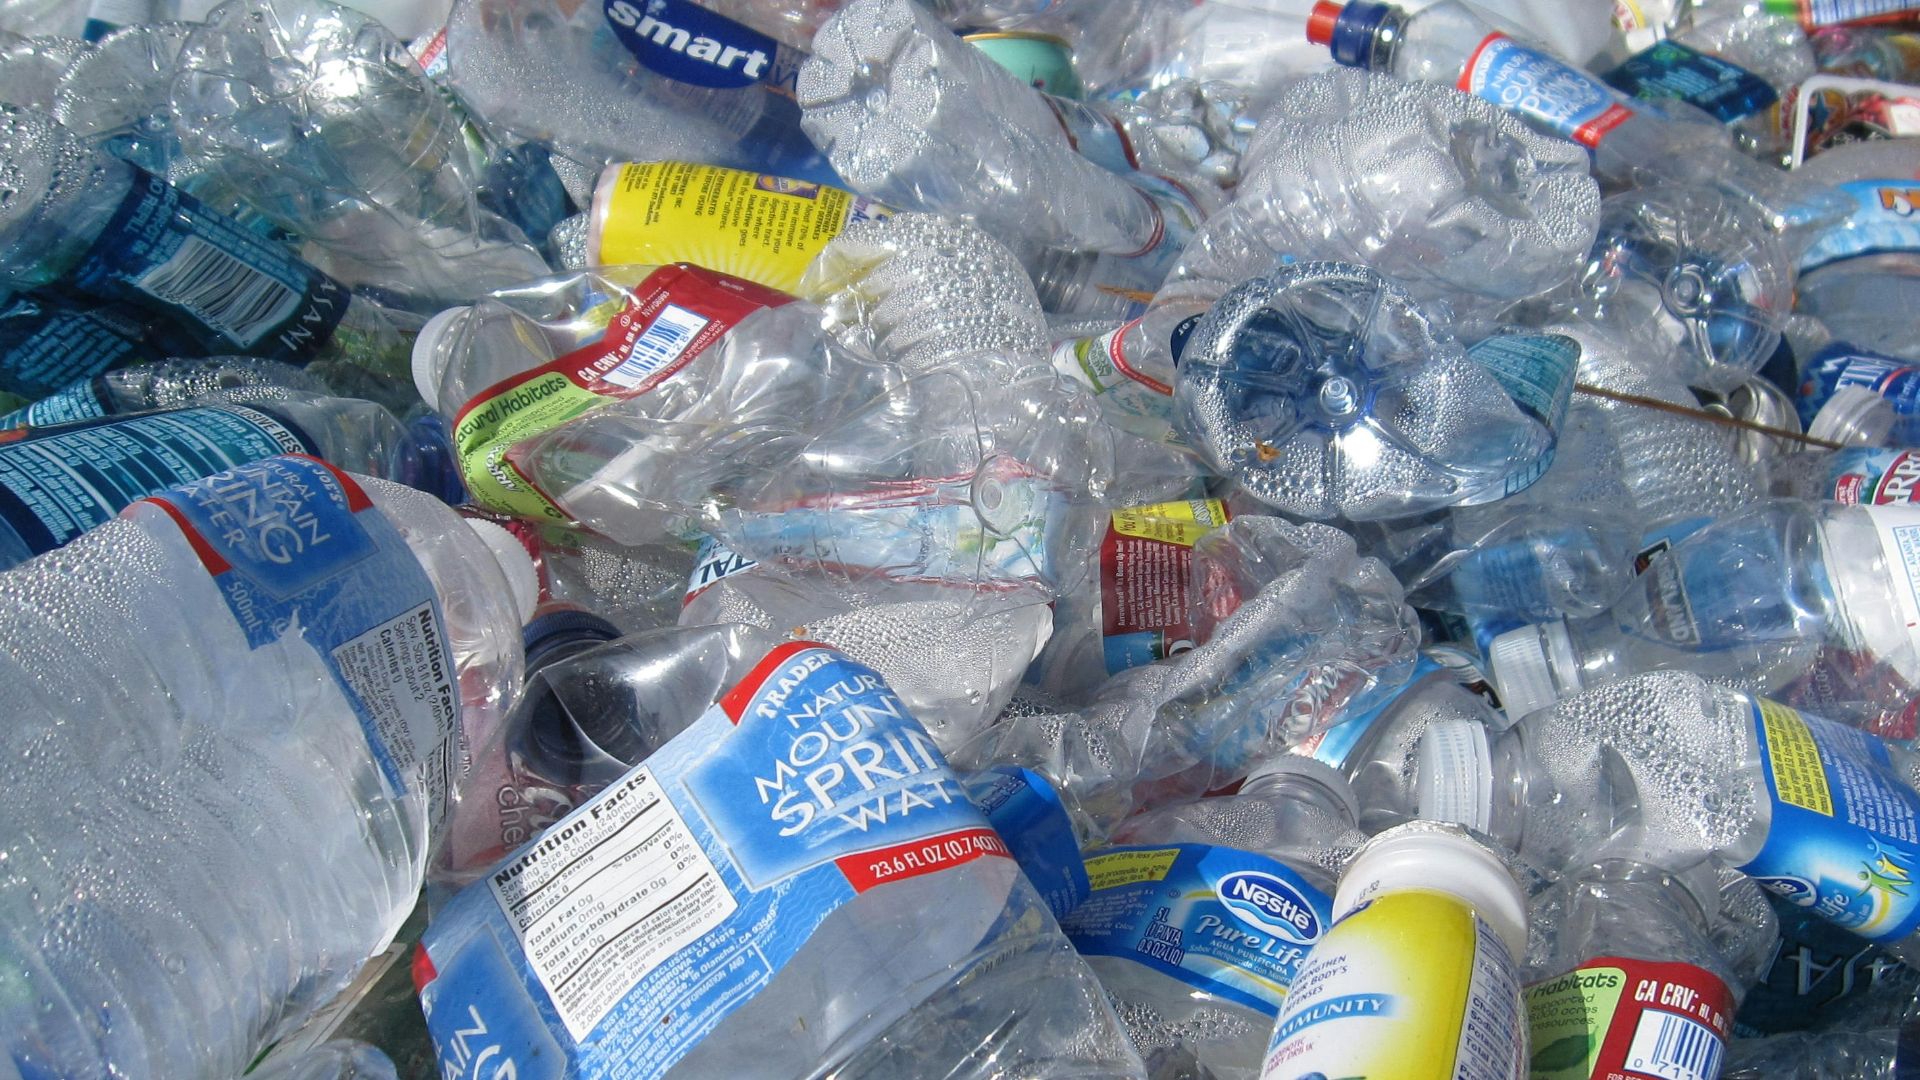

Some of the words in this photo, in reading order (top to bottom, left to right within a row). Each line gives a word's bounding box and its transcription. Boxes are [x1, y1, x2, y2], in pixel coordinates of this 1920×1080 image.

[607, 0, 767, 78] smart
[694, 194, 706, 216] USING
[738, 229, 747, 247] goes
[752, 216, 763, 239] where
[772, 237, 781, 254] your
[785, 216, 797, 246] immune
[576, 362, 600, 385] CA
[454, 401, 500, 447] atural
[497, 372, 568, 416] Habitats
[311, 466, 345, 507] JOE'S
[225, 578, 263, 633] 500mL
[378, 628, 400, 674] Calories
[392, 674, 402, 683] 0
[393, 621, 411, 665] Servings
[405, 665, 420, 692] about
[413, 693, 424, 701] 2
[412, 642, 425, 663] Size
[417, 663, 427, 671] 8
[418, 608, 444, 682] Nutrition
[437, 685, 456, 730] Facts
[756, 653, 836, 719] TRADER
[754, 694, 903, 804] MOUN
[493, 816, 587, 887] Nutrition
[589, 771, 648, 821] Facts
[499, 865, 541, 897] Serving
[538, 848, 563, 868] Size
[561, 842, 571, 851] 8
[569, 835, 579, 845] fl
[578, 827, 593, 840] oz
[593, 793, 638, 830] (240mL)
[504, 869, 552, 905] Servings
[550, 856, 568, 872] Per
[567, 820, 618, 859] Container
[617, 798, 647, 823] about
[646, 790, 656, 800] 3
[868, 855, 905, 878] 23.6
[905, 850, 925, 868] FL
[924, 845, 942, 863] OZ
[511, 888, 546, 917] Amount
[544, 878, 562, 893] Per
[560, 853, 595, 880] Serving
[517, 891, 561, 928] Calories
[560, 884, 569, 894] 0
[527, 920, 557, 947] Total
[557, 904, 577, 924] Fat
[576, 892, 595, 908] 0g
[661, 831, 683, 850] 0%
[534, 921, 578, 959] Sodium
[577, 900, 606, 924] 0mg
[668, 841, 691, 861] 0%
[673, 893, 705, 917] dietary
[1233, 878, 1311, 932] Nestlé
[541, 945, 571, 972] Total
[570, 886, 649, 947] Carbohydrate
[648, 874, 668, 890] 0g
[675, 852, 697, 871] 0%
[613, 927, 642, 949] source
[640, 920, 650, 930] of
[649, 899, 682, 924] calories
[681, 886, 702, 903] from
[619, 938, 648, 962] vitamin
[656, 914, 686, 936] calcium
[685, 904, 701, 917] and
[1198, 914, 1263, 950] Pure
[602, 970, 623, 990] Daily
[619, 944, 657, 976] Values
[656, 934, 673, 948] are
[672, 914, 703, 937] based
[703, 907, 716, 918] on
[695, 945, 709, 958] CA
[736, 930, 752, 945] CA
[1209, 939, 1234, 952] AGUA
[1236, 947, 1289, 976] PURIFICADA
[549, 946, 590, 985] Protein
[587, 933, 607, 948] 0g
[726, 954, 745, 973] AND
[745, 948, 755, 958] A
[600, 975, 631, 1007] calorie
[628, 980, 649, 1003] SOLD
[1534, 971, 1618, 999] Habitats
[1634, 978, 1659, 1003] CA
[1560, 1005, 1597, 1016] acres
